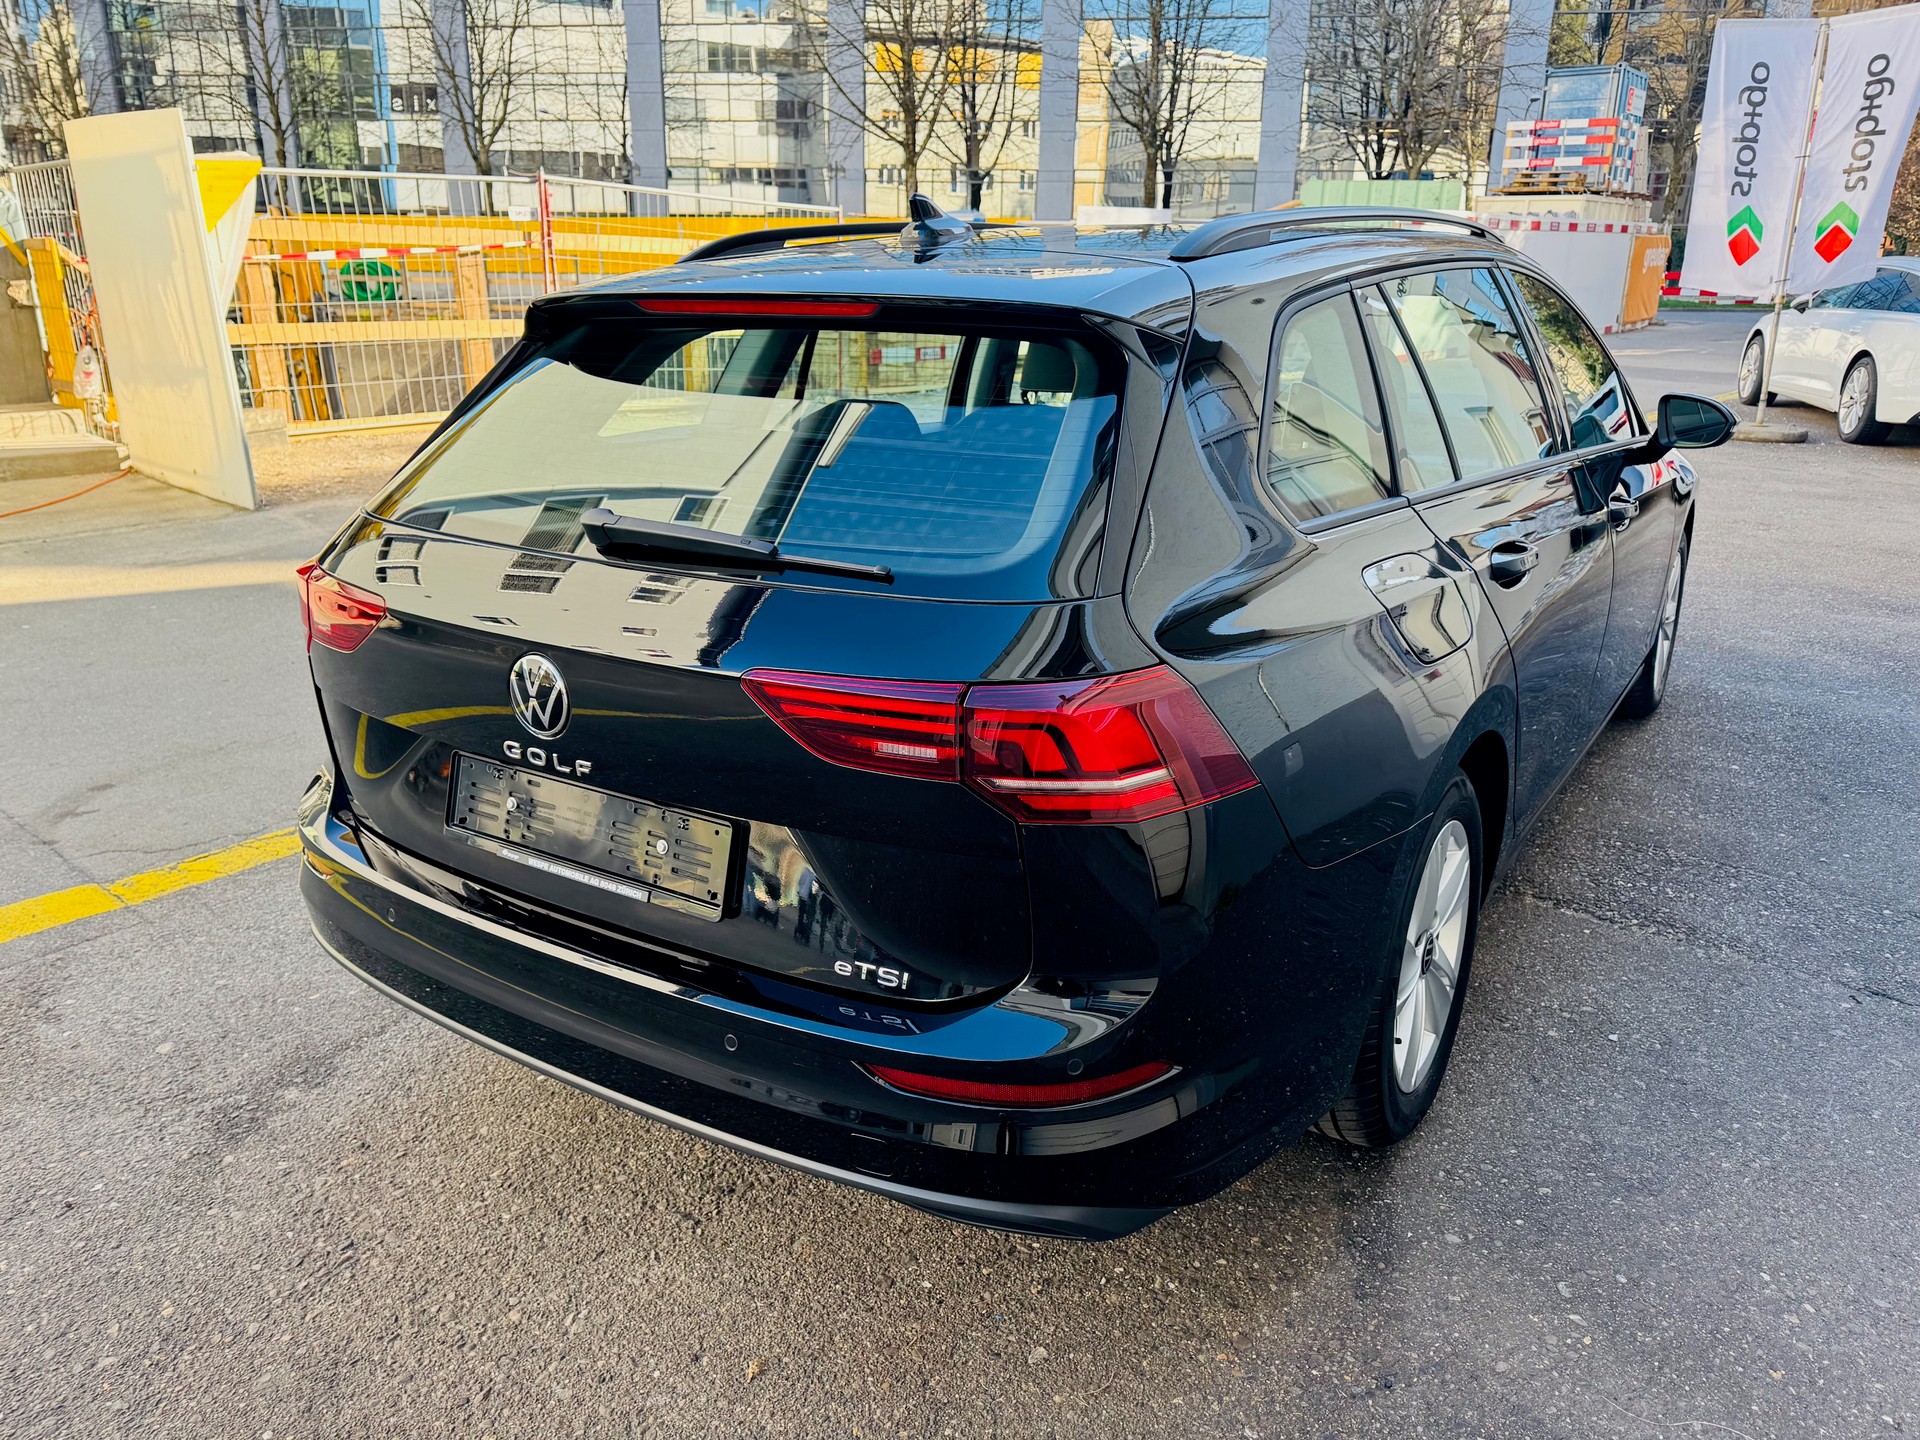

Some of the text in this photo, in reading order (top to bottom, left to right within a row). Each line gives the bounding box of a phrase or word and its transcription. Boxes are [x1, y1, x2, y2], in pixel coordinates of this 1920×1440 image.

[503, 740, 593, 777] GOLF
[549, 863, 590, 884] AUTOMOBILE
[834, 960, 909, 990] eTSI
